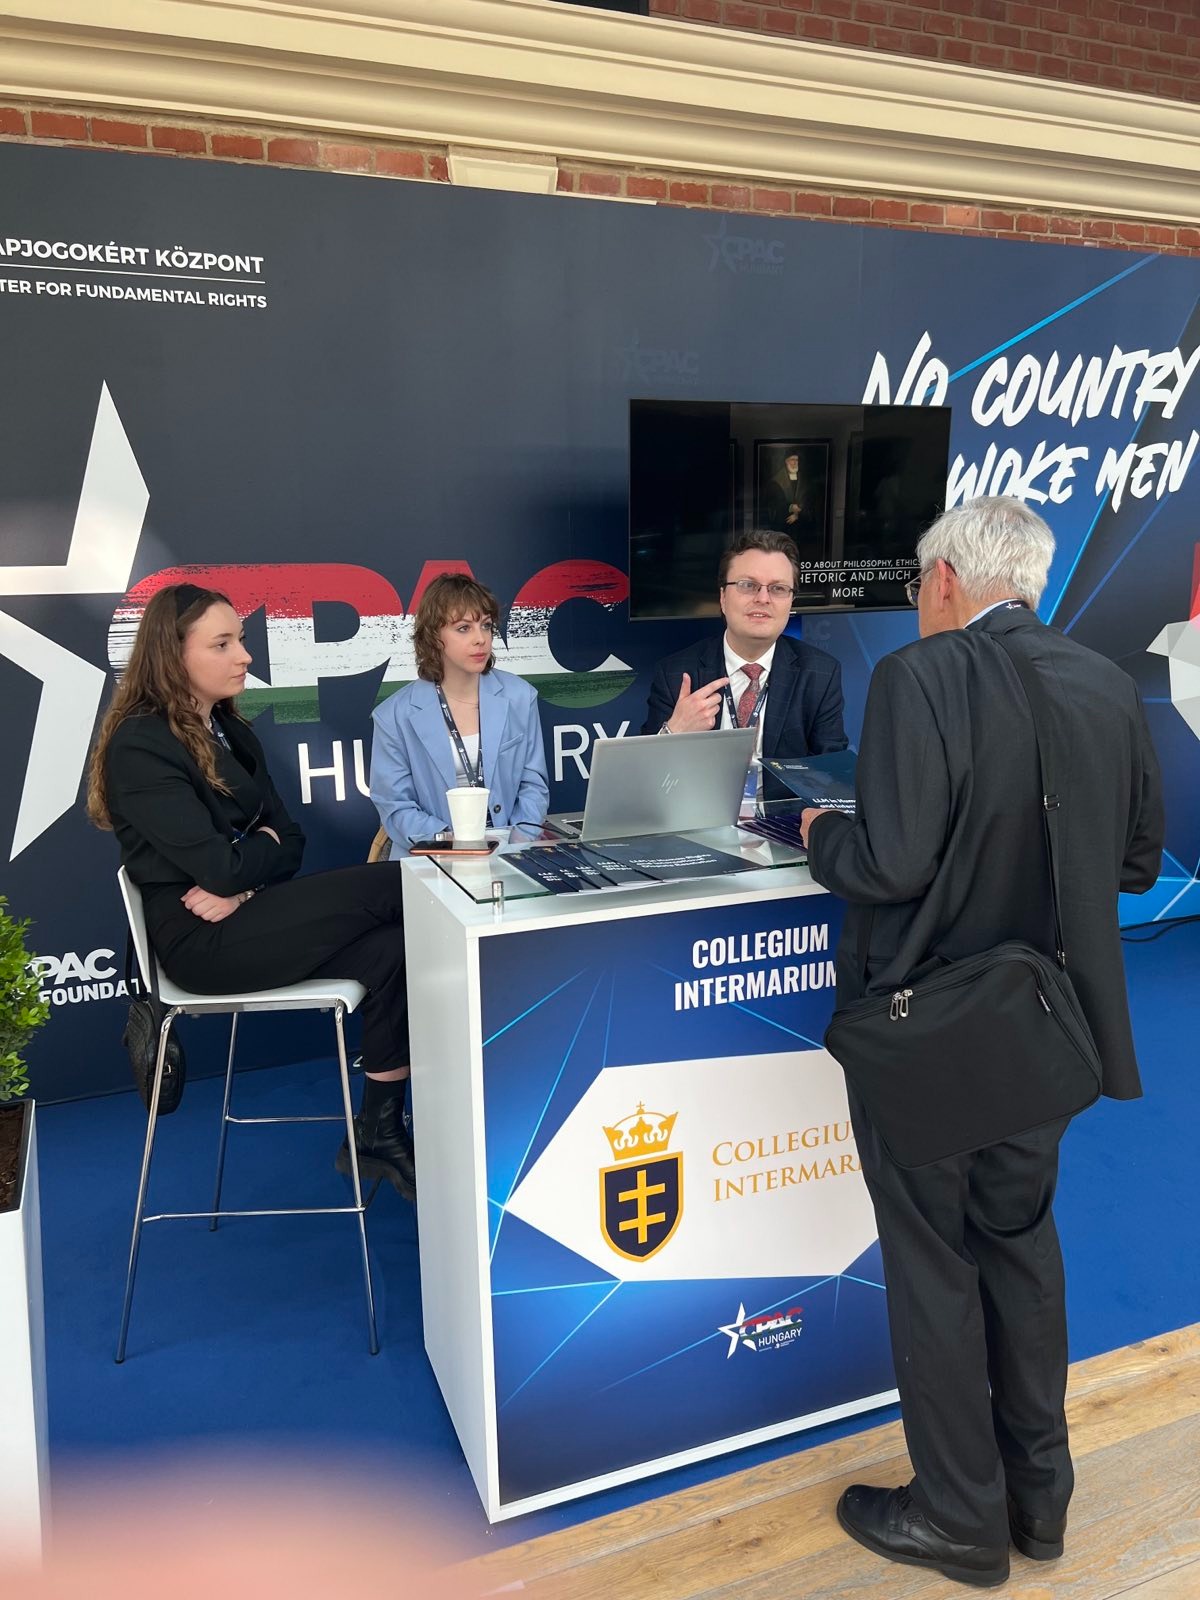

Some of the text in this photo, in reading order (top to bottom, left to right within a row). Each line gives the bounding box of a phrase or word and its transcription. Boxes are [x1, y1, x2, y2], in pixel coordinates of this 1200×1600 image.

[155, 246, 264, 273] KÖZPONT
[36, 281, 72, 296] FOR
[76, 284, 205, 305] FUNDAMENTAL
[208, 292, 267, 308] RIGHTS
[861, 330, 1200, 427] NO COUNTRY
[945, 430, 1200, 513] WOKE MEN
[813, 560, 841, 569] ABOUT
[843, 559, 893, 568] PHILOSOPHY,
[850, 571, 875, 582] AND
[878, 570, 911, 581] MUCH
[832, 587, 865, 598] MORE
[692, 923, 829, 969] COLLEGIUM
[25, 948, 118, 986] PAC
[712, 1120, 855, 1167] COLLEGIU
[714, 1153, 862, 1203] INTERMAR
[758, 1327, 803, 1347] HUNGARY
